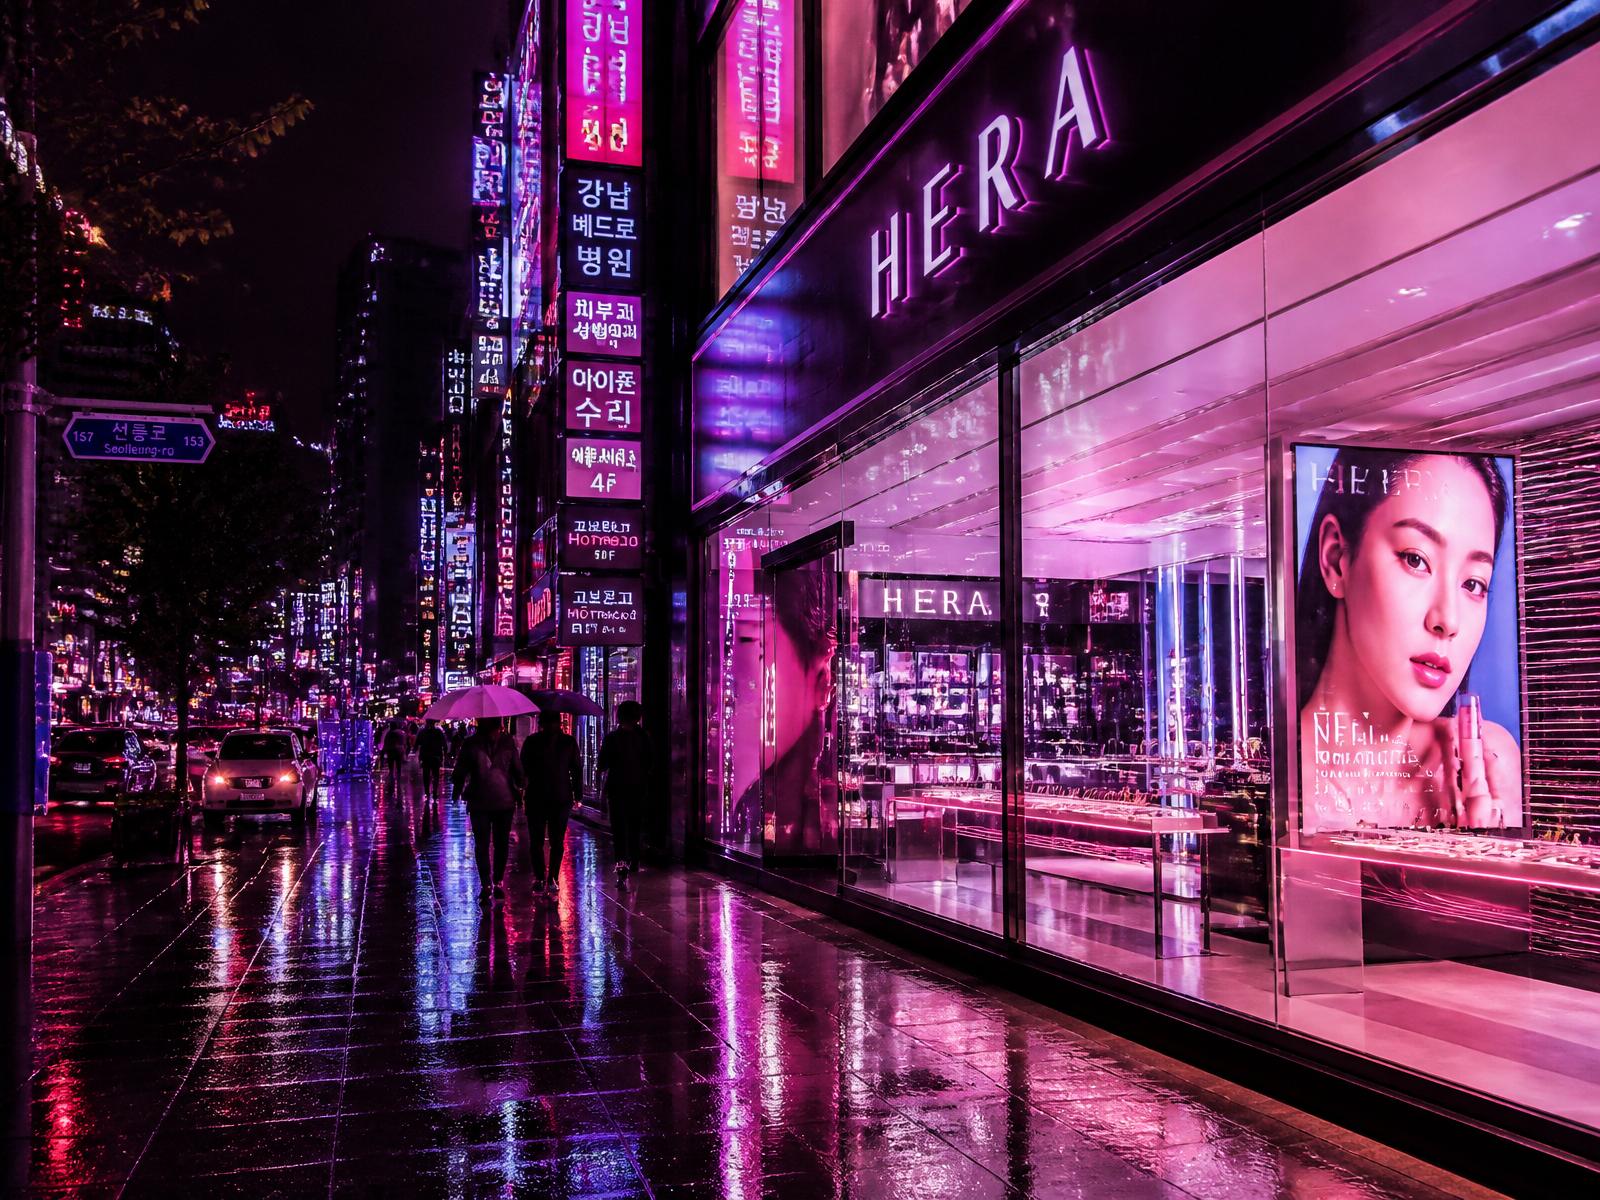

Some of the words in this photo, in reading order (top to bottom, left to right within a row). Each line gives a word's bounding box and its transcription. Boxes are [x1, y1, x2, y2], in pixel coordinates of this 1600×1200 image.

[578, 179, 631, 211] 강남
[871, 45, 1106, 319] HERA
[577, 245, 631, 278] 병원
[572, 367, 636, 395] 아이폰
[575, 396, 631, 428] 수리
[72, 430, 94, 443] 157
[183, 435, 205, 448] 153
[590, 472, 617, 493] 4F
